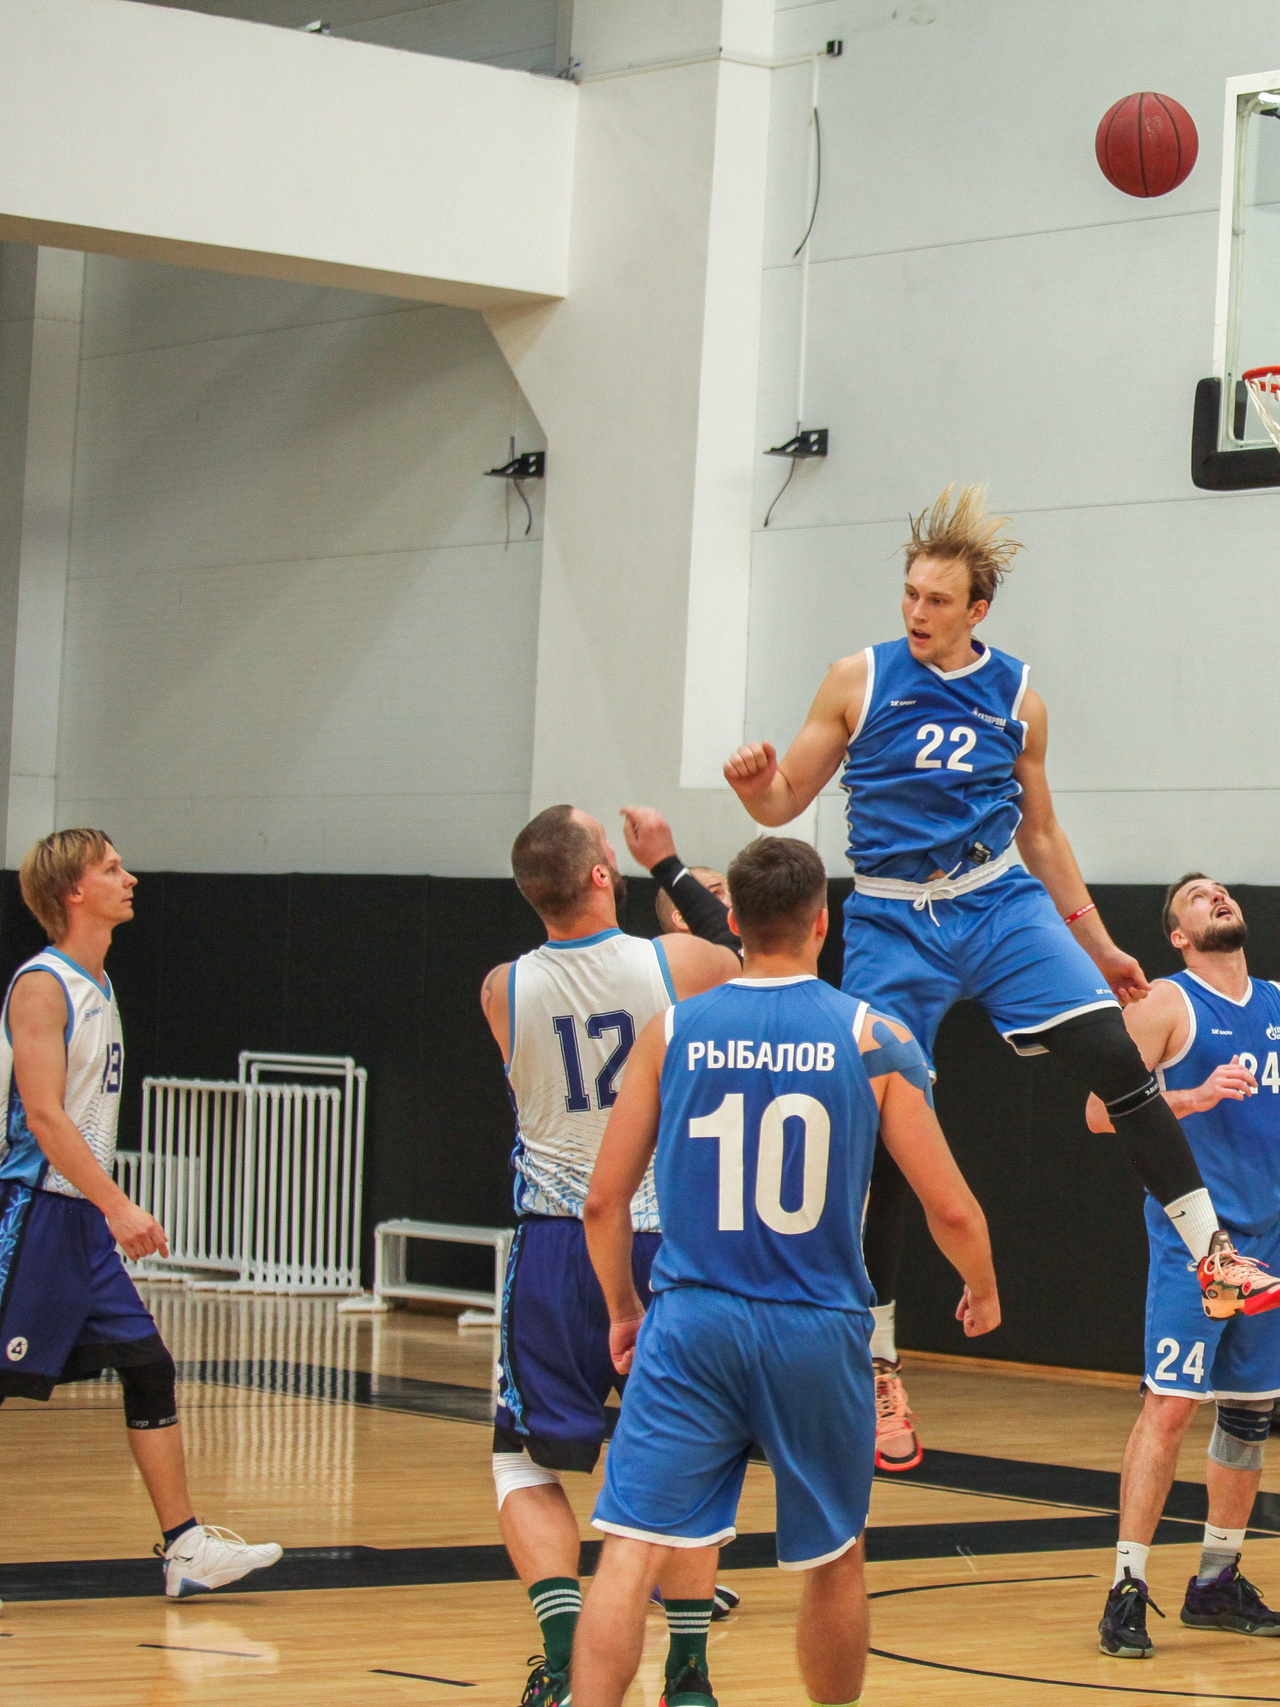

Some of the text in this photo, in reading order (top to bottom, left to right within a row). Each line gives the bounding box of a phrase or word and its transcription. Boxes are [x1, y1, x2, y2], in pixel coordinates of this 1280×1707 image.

[914, 723, 977, 773] 22
[552, 1009, 637, 1113] 12
[688, 1040, 836, 1072] РЫБАЛОВ
[688, 1092, 831, 1235] 10
[1155, 1337, 1206, 1384] 24
